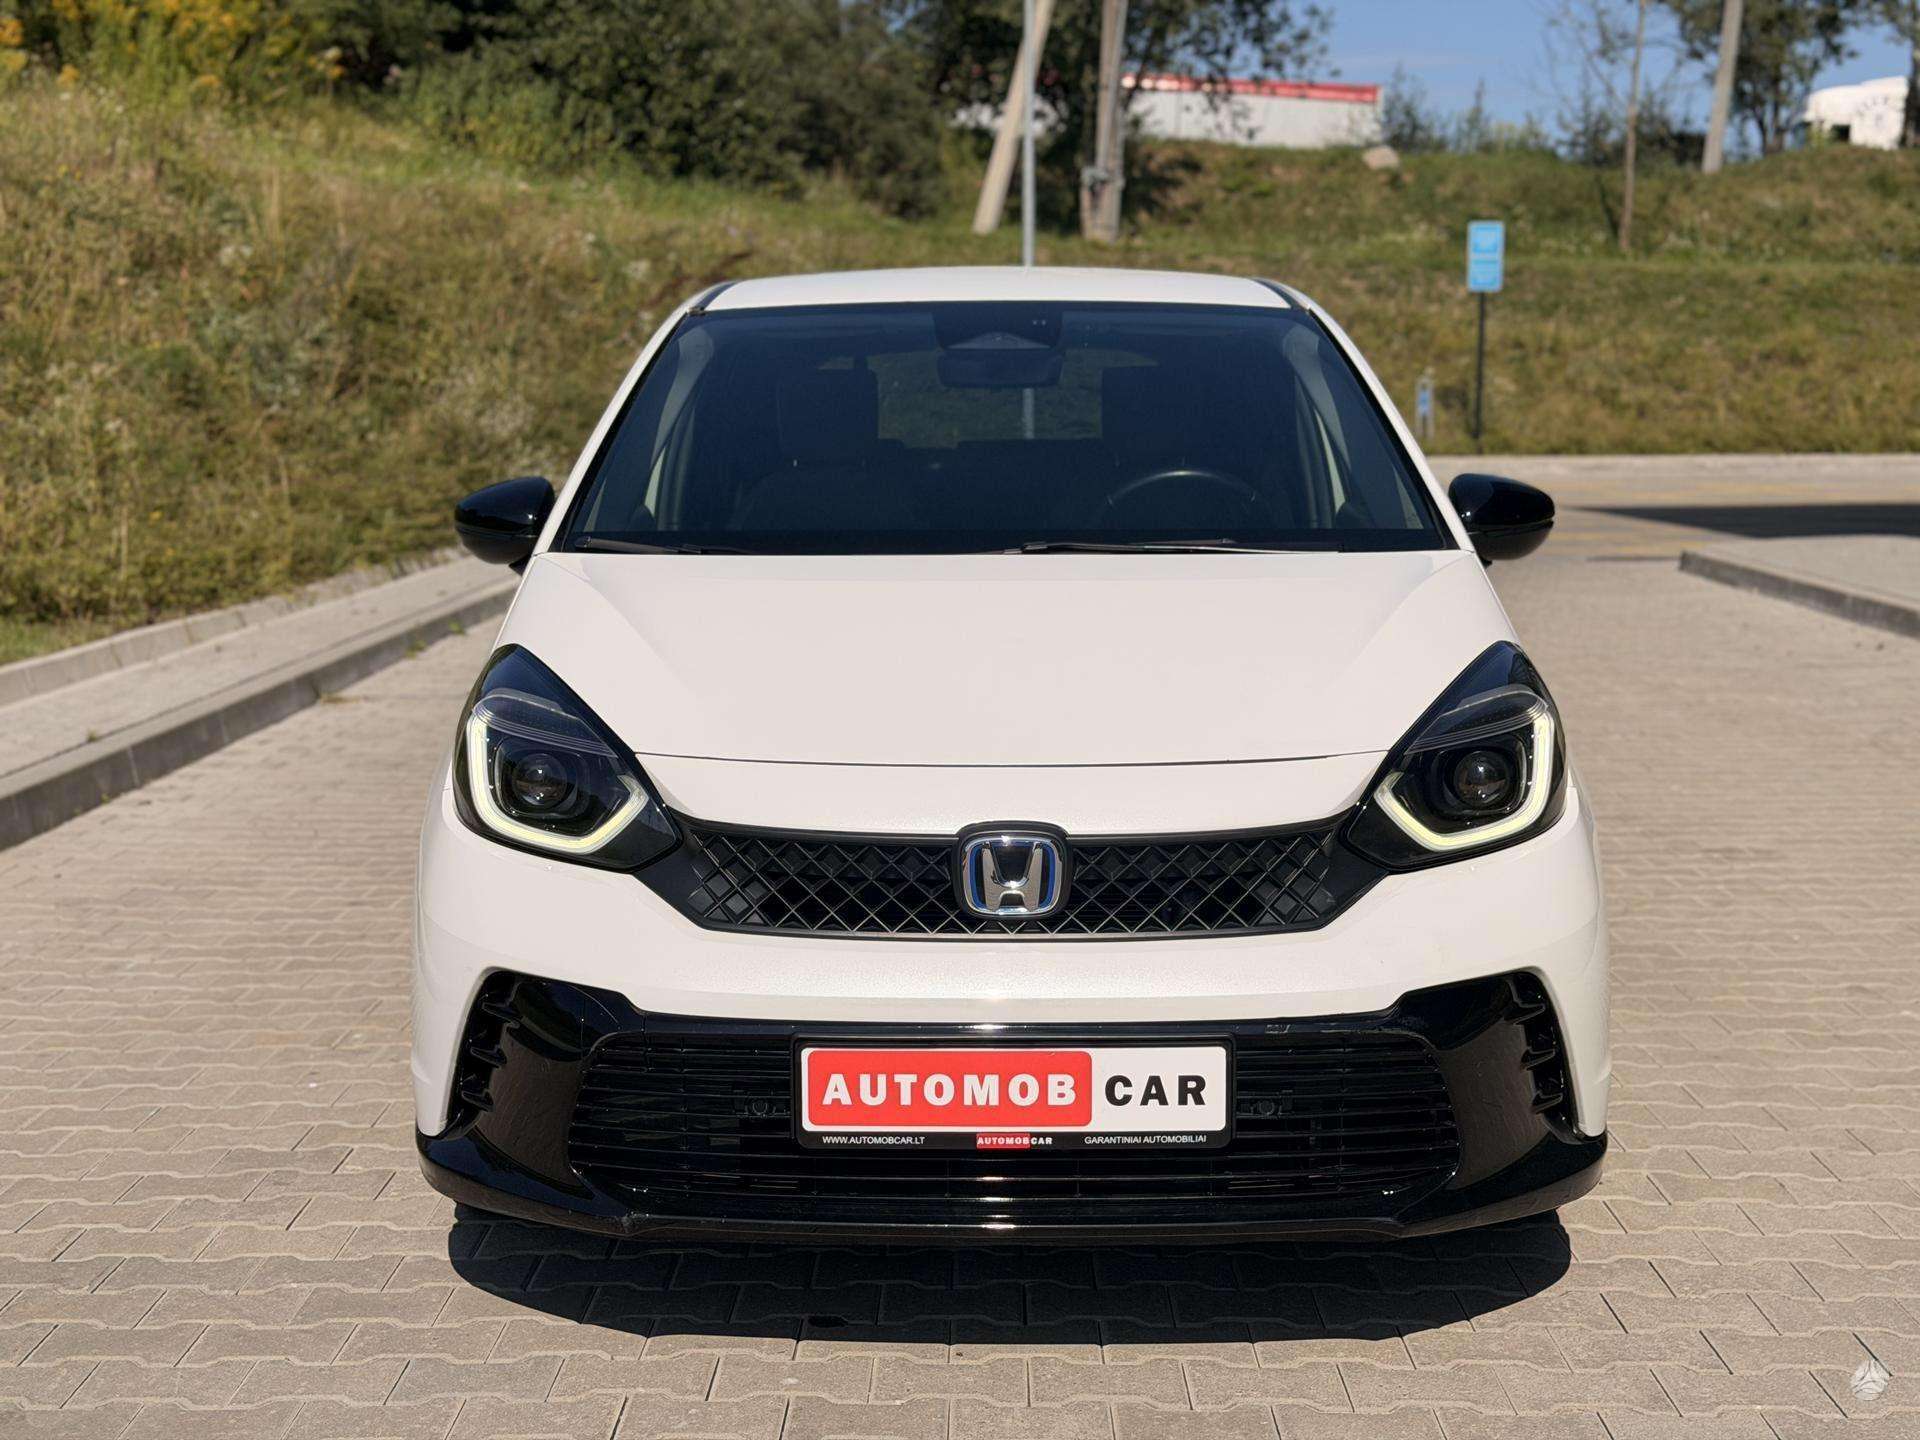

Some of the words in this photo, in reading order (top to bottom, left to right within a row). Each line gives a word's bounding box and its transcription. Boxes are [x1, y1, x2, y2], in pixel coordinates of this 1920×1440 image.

[822, 1073, 1077, 1106] AUTOMOB
[1105, 1075, 1206, 1106] CAR
[822, 1136, 925, 1145] WWW.AUTOMOBCAR.LT
[1084, 1136, 1142, 1145] GARANTINIAI
[1143, 1135, 1206, 1145] AUTOMOBILIAI
